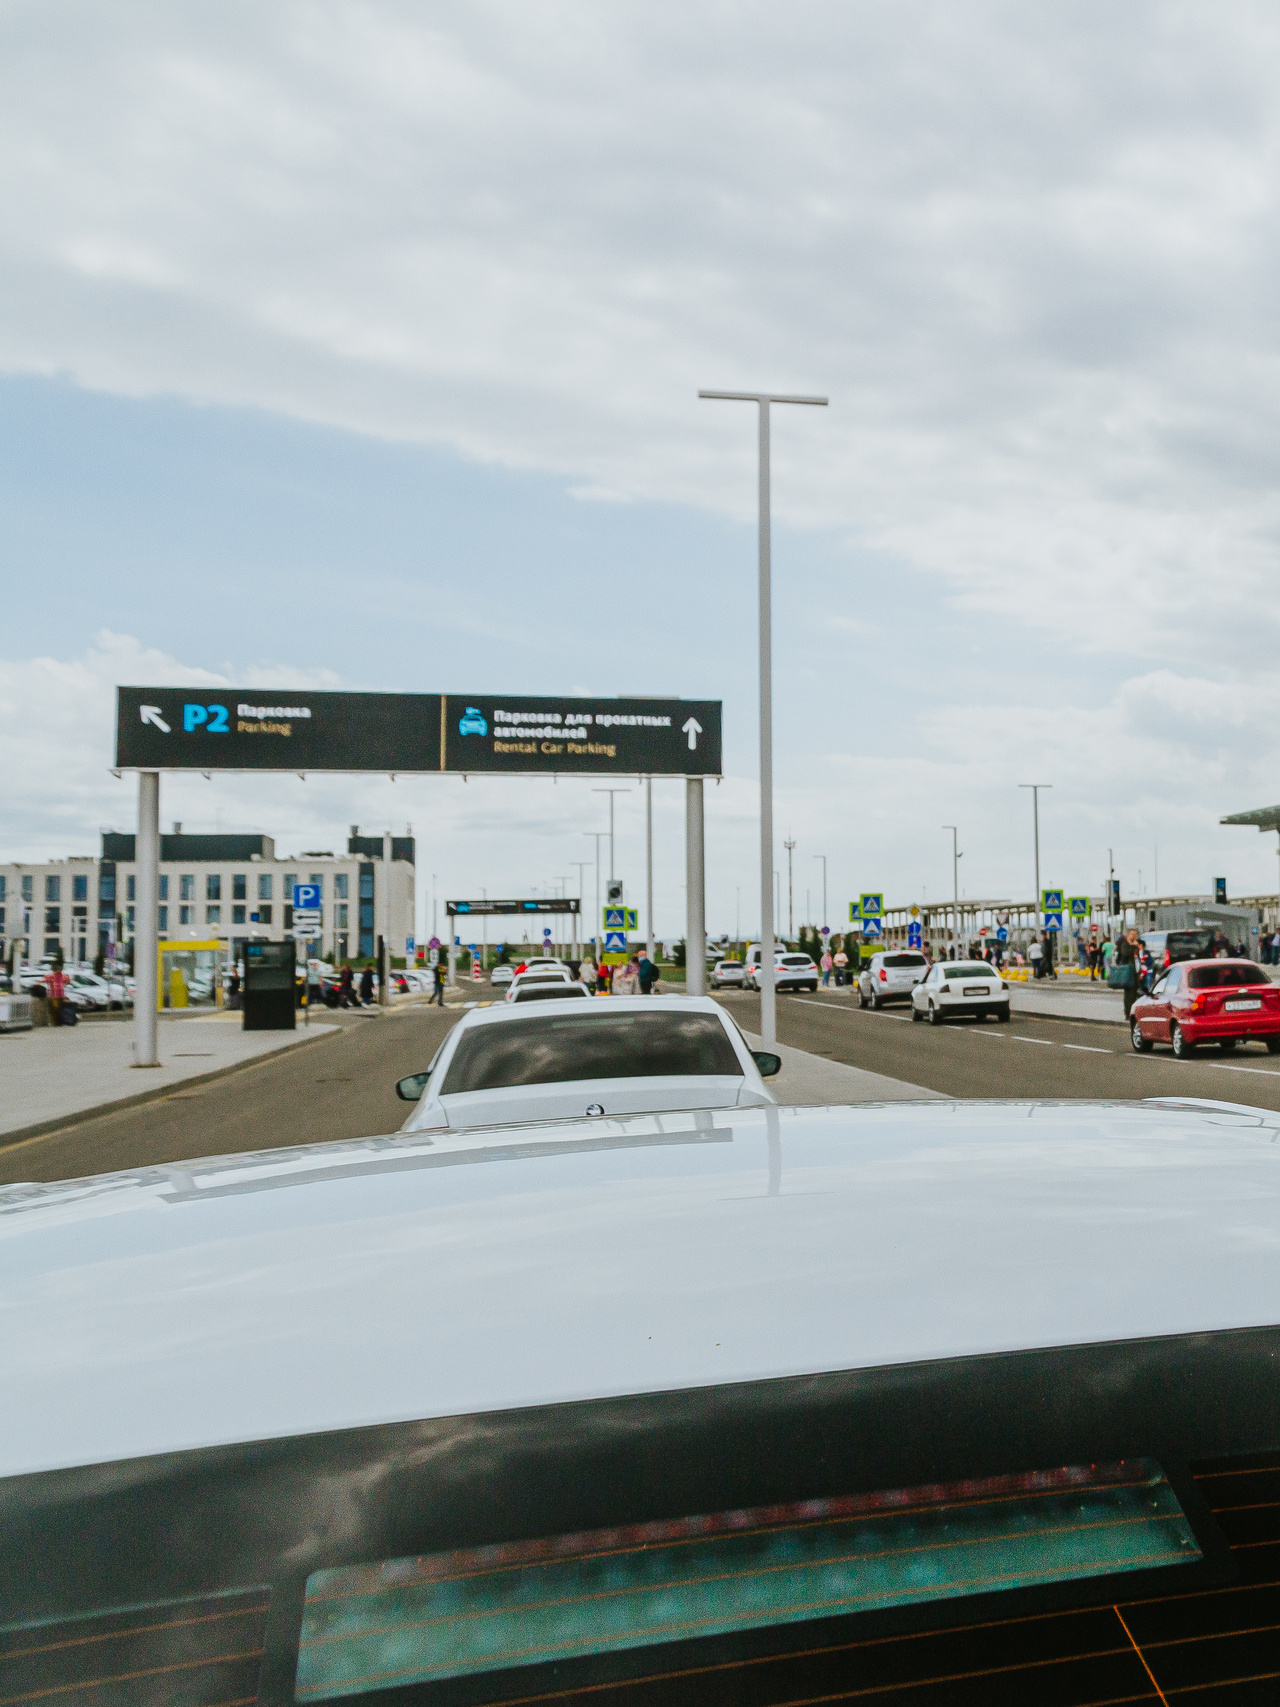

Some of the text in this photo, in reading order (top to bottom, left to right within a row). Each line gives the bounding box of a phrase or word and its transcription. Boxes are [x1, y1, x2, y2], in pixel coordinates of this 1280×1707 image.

[183, 703, 230, 733] P2
[237, 703, 312, 720] Парковка
[493, 709, 672, 728] Парковка для прокатных
[237, 720, 292, 737] Parking
[493, 725, 588, 740] автомобилей
[493, 740, 617, 758] Rental Car Parking
